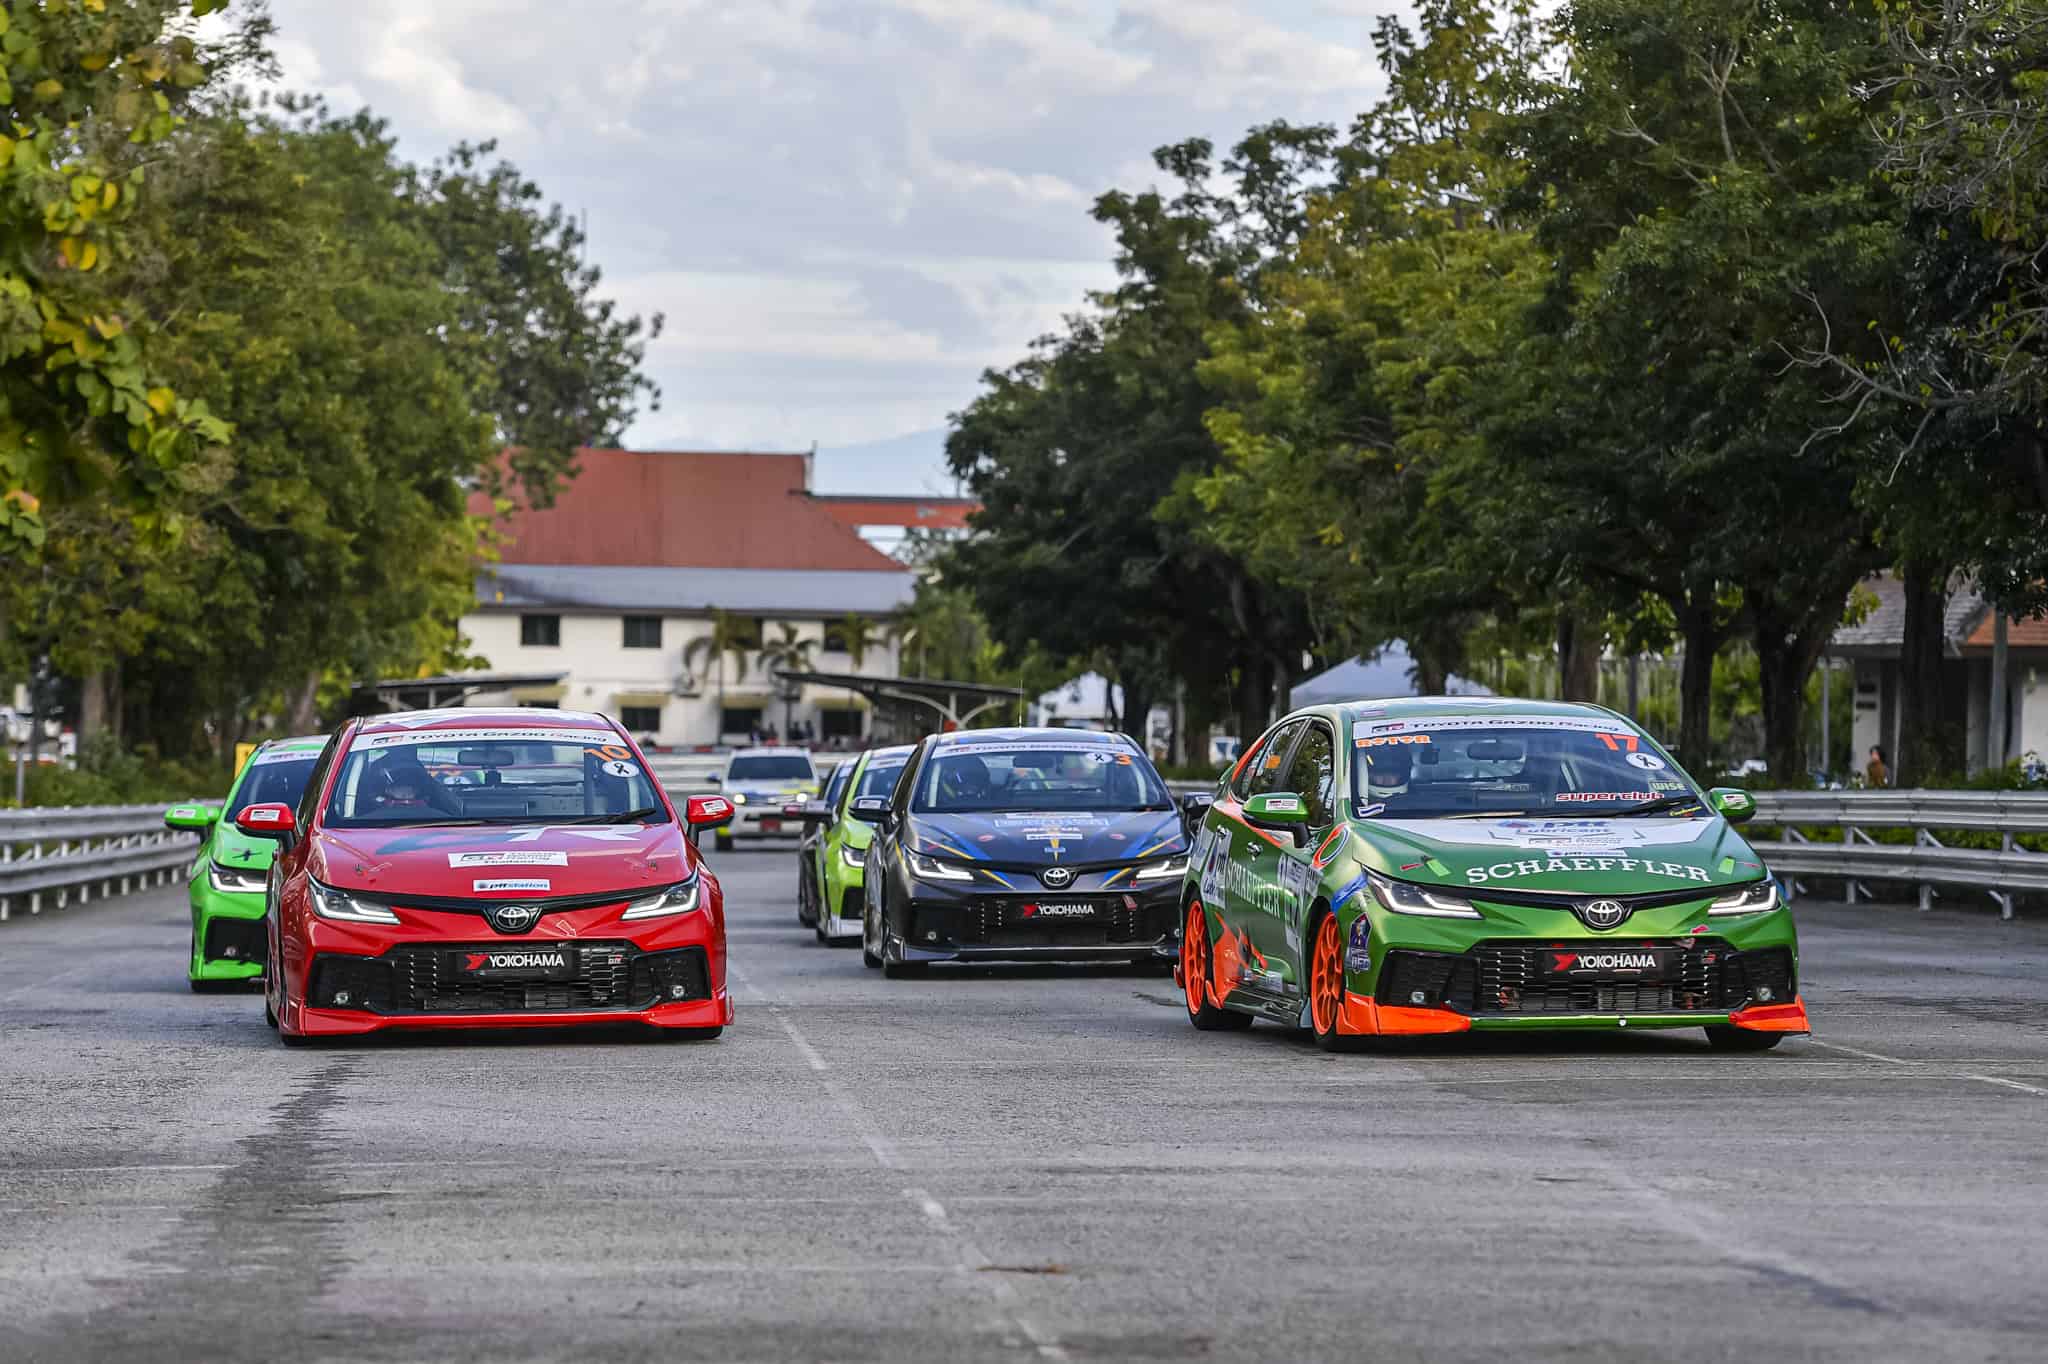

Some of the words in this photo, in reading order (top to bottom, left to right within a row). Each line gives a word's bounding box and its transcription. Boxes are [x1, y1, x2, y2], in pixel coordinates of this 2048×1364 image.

[1595, 733, 1639, 752] 17
[584, 745, 632, 762] 10
[1115, 754, 1132, 766] 3
[1466, 858, 1711, 884] SCHAEFFLER
[1039, 904, 1095, 915] YOKOHAMA
[489, 953, 565, 968] YOKOHAMA
[1577, 954, 1656, 969] YOKOHAMA
